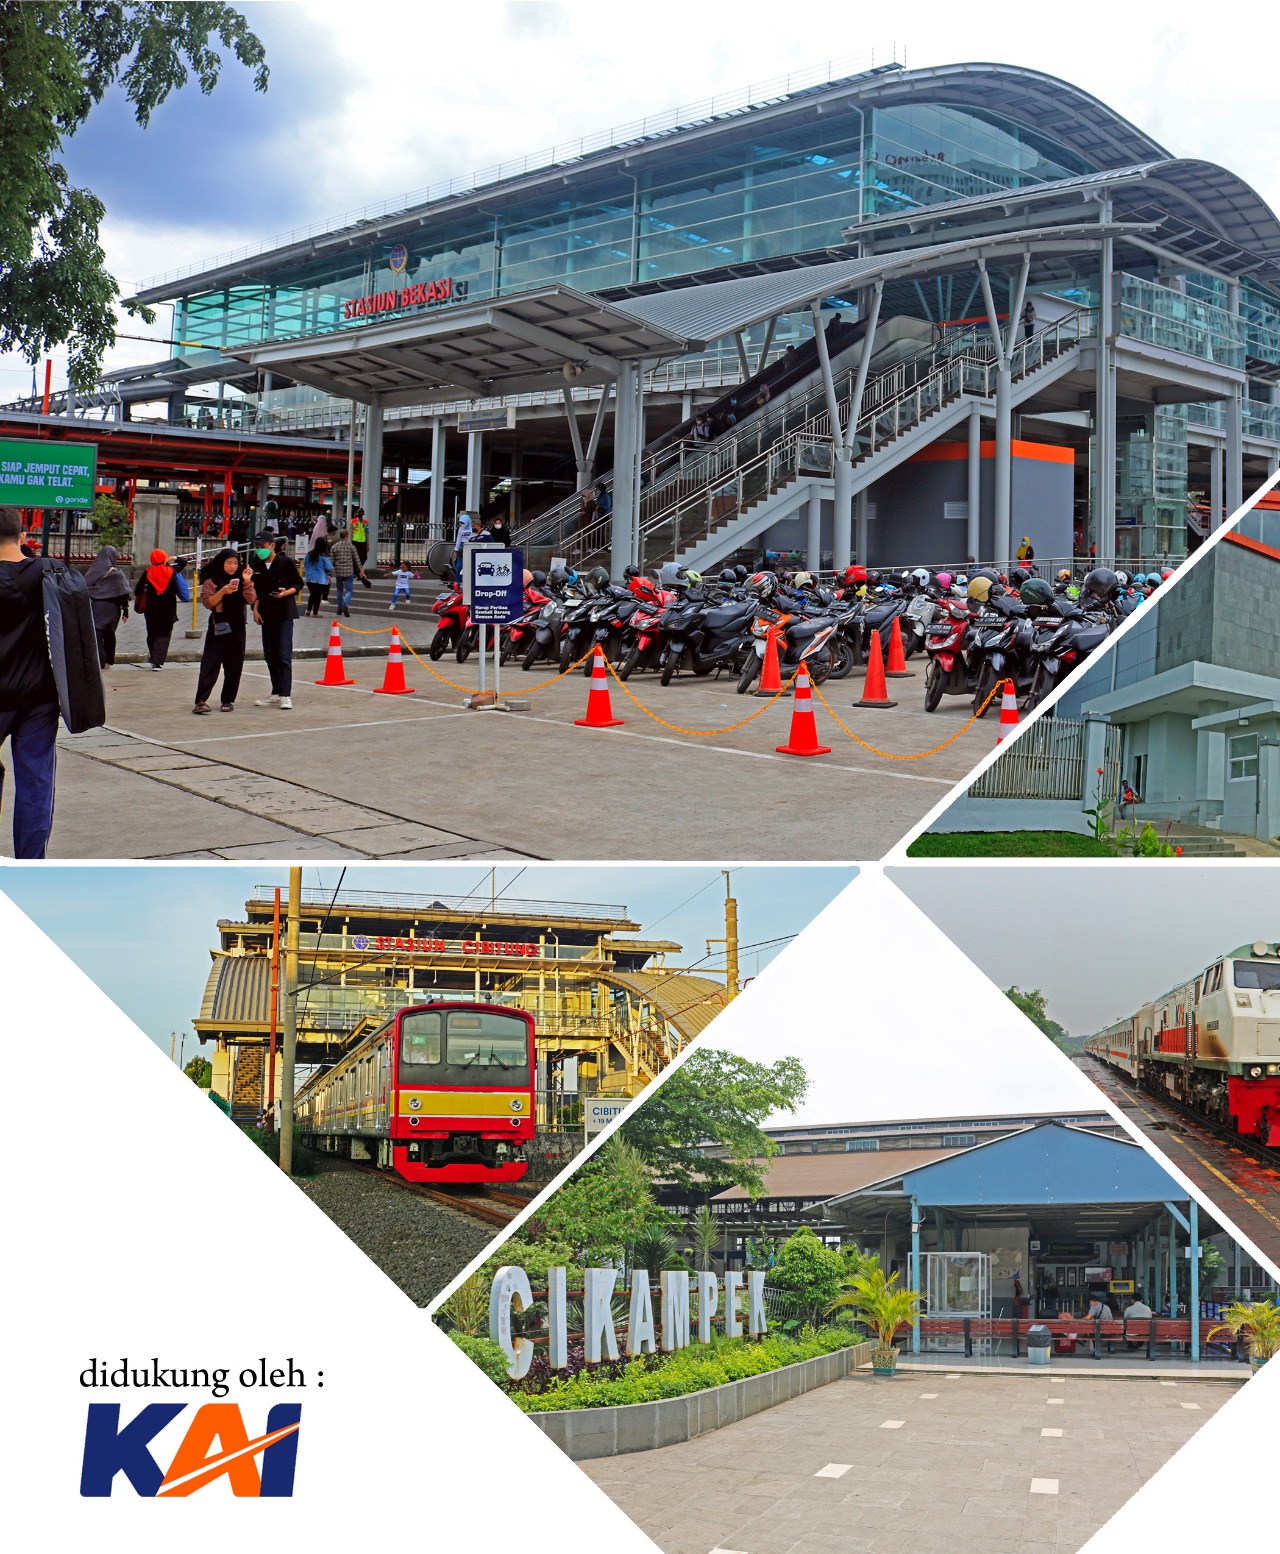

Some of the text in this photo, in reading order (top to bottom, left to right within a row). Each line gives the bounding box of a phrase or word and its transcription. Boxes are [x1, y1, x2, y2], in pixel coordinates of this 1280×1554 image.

[344, 277, 452, 319] STASIUN BEKASI
[1, 461, 90, 478] SIAP JEMPUT CEPAT,
[27, 475, 45, 486] GAK
[47, 476, 74, 487] TELAT.
[475, 590, 507, 598] Drop-Off
[375, 936, 539, 956] STASIUN CIBITUNG
[489, 1265, 767, 1380] CIKAMPEK
